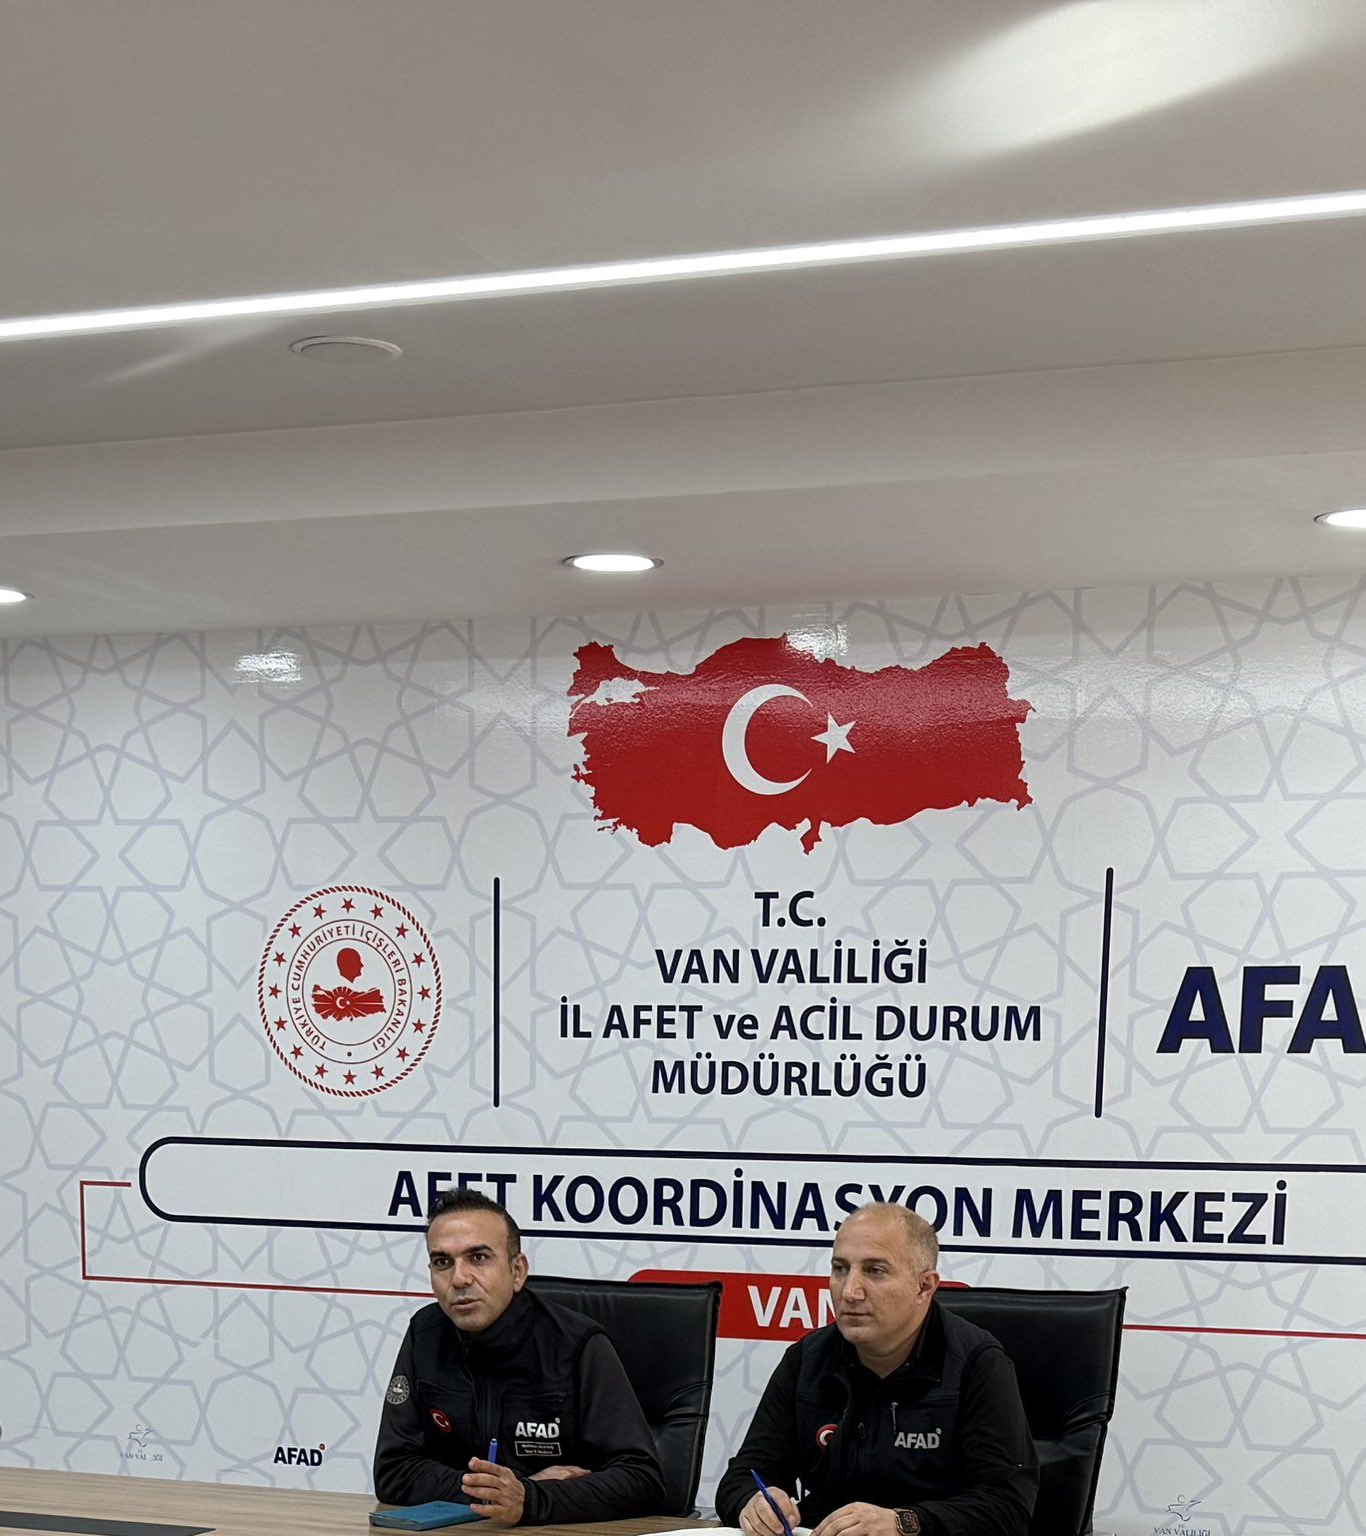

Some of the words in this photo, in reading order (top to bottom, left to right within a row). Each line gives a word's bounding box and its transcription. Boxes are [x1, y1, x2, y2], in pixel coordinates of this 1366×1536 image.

[754, 890, 827, 928] T.C.
[292, 922, 356, 991] CUMHURİYETİ
[360, 925, 405, 974] İÇİŞLERİ
[655, 948, 740, 984] VAN
[750, 938, 928, 984] VALİLİĞİ
[292, 997, 327, 1051] TÜRKİYE
[372, 978, 408, 1051] BAKANLIĞI
[560, 995, 592, 1039] İL
[602, 1004, 704, 1040] AFET
[713, 1011, 760, 1041] ve
[770, 996, 863, 1042] ACİL
[875, 1004, 1042, 1043] DURUM
[651, 1051, 927, 1099] MÜDÜRLÜĞÜ
[1011, 1179, 1288, 1246] MERKEZİ
[514, 1421, 560, 1439] AFAD
[894, 1431, 940, 1449] AFAD
[273, 1446, 323, 1466] AFAD
